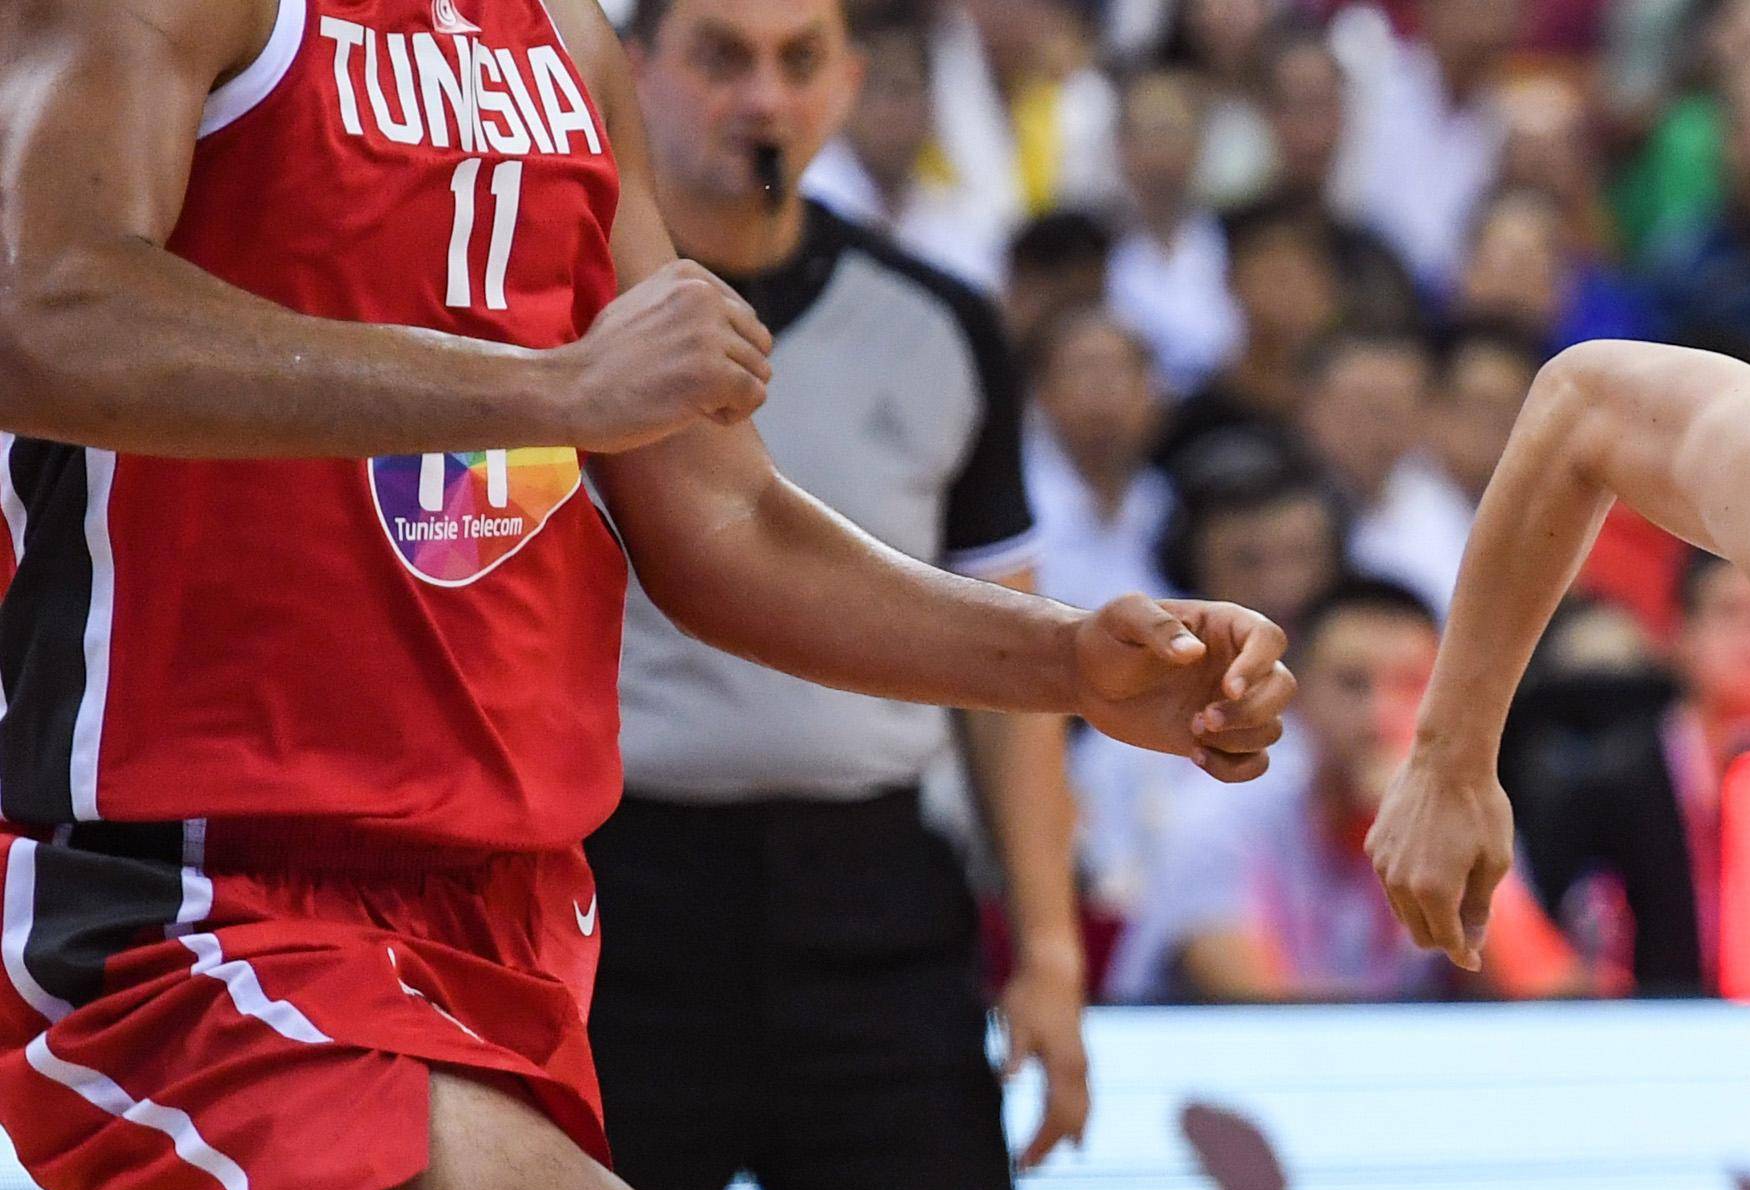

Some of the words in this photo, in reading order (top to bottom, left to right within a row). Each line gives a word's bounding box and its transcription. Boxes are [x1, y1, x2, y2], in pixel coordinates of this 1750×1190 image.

[319, 15, 602, 155] TUNISIA
[445, 158, 523, 310] 11
[394, 515, 459, 542] Tunisie
[462, 513, 523, 539] Telecom
